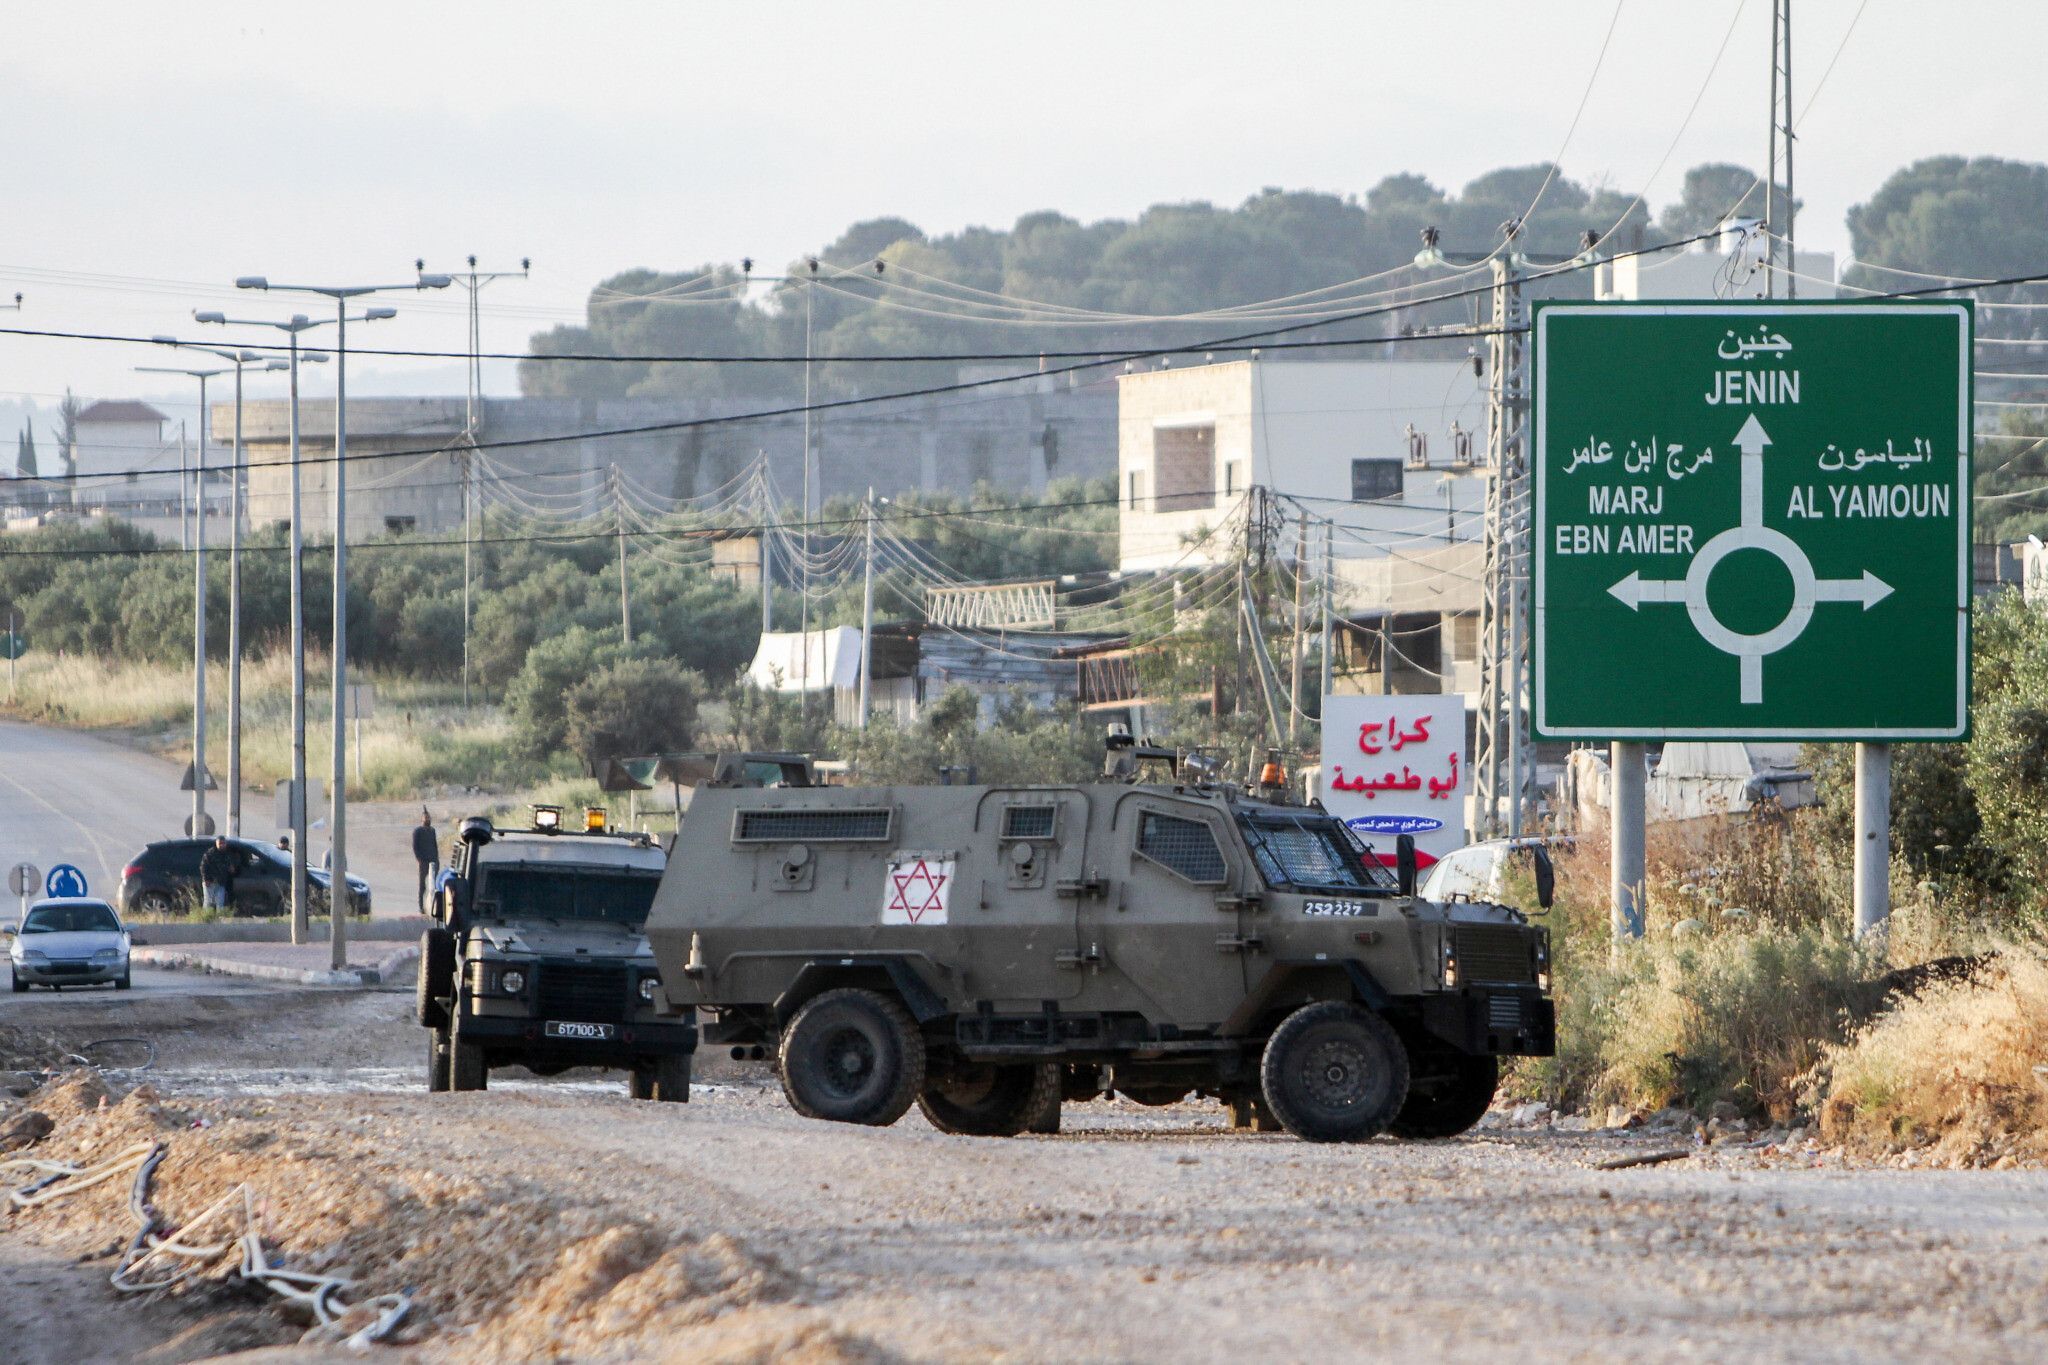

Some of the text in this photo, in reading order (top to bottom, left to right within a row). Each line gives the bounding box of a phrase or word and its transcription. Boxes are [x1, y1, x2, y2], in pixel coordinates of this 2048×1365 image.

[1718, 325, 1792, 359] جنين
[1705, 370, 1799, 404] JENIN
[1563, 436, 1712, 479] مرج ابن عامر
[1590, 486, 1662, 514] MARJ
[1788, 484, 1949, 517] AL YAMOUN
[1556, 525, 1696, 556] EBN AMER
[1359, 716, 1431, 754] كراج
[1332, 752, 1458, 798] أبو طعيمة
